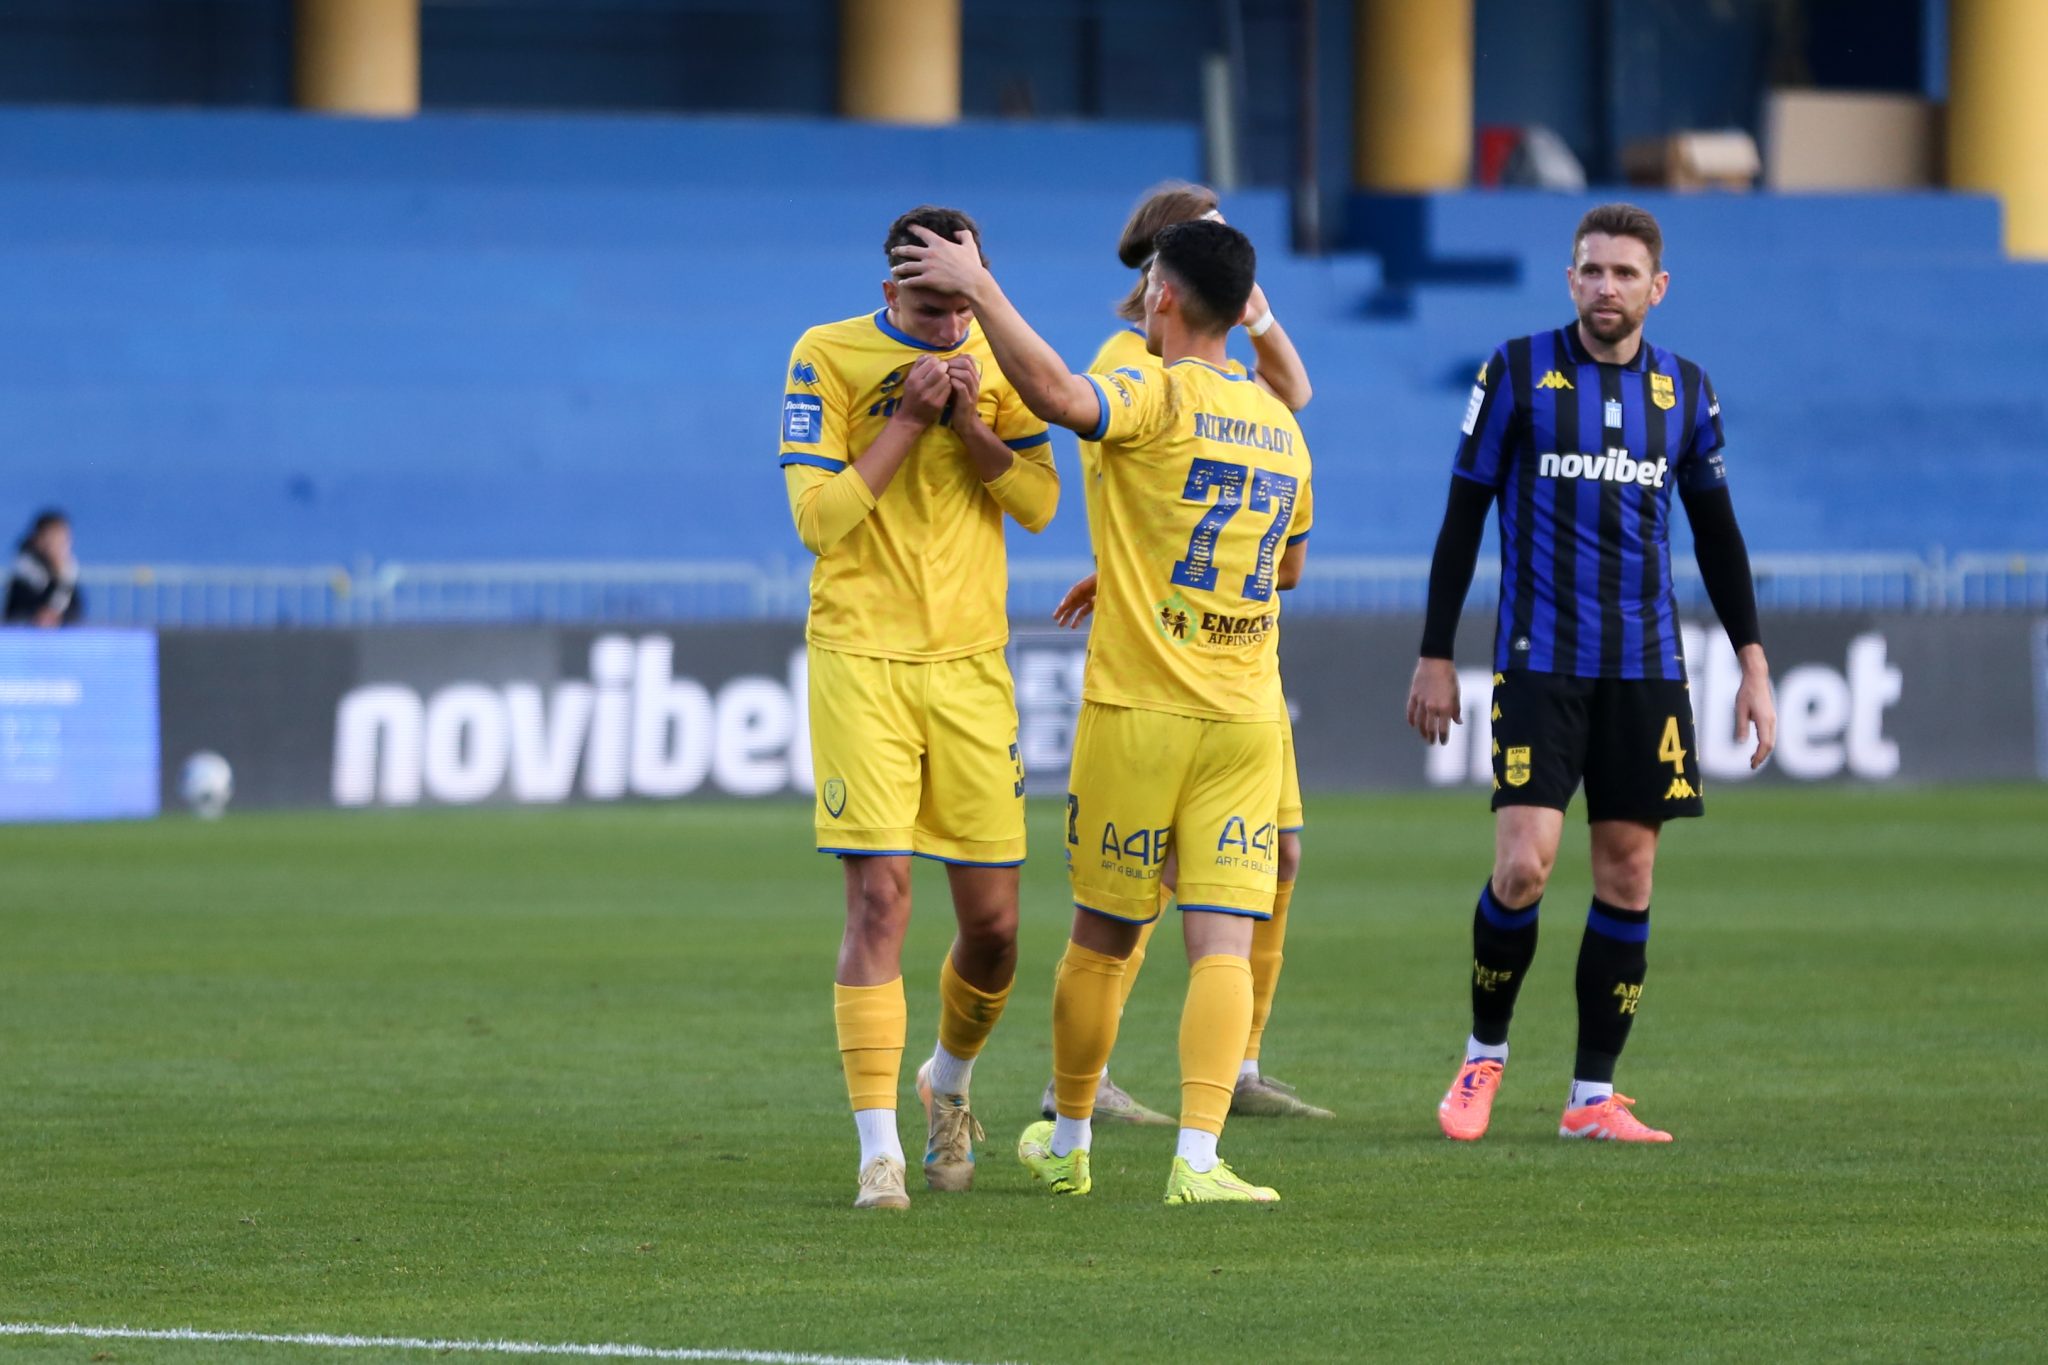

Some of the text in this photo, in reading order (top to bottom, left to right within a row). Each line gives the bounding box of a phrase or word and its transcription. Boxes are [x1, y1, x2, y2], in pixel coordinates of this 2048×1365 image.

[1539, 448, 1668, 488] novibet
[1171, 457, 1298, 602] 77
[1659, 716, 1687, 774] 4
[1216, 856, 1240, 867] ART
[1241, 859, 1249, 869] 4
[1613, 982, 1643, 998] ARI
[1620, 999, 1638, 1014] FC
